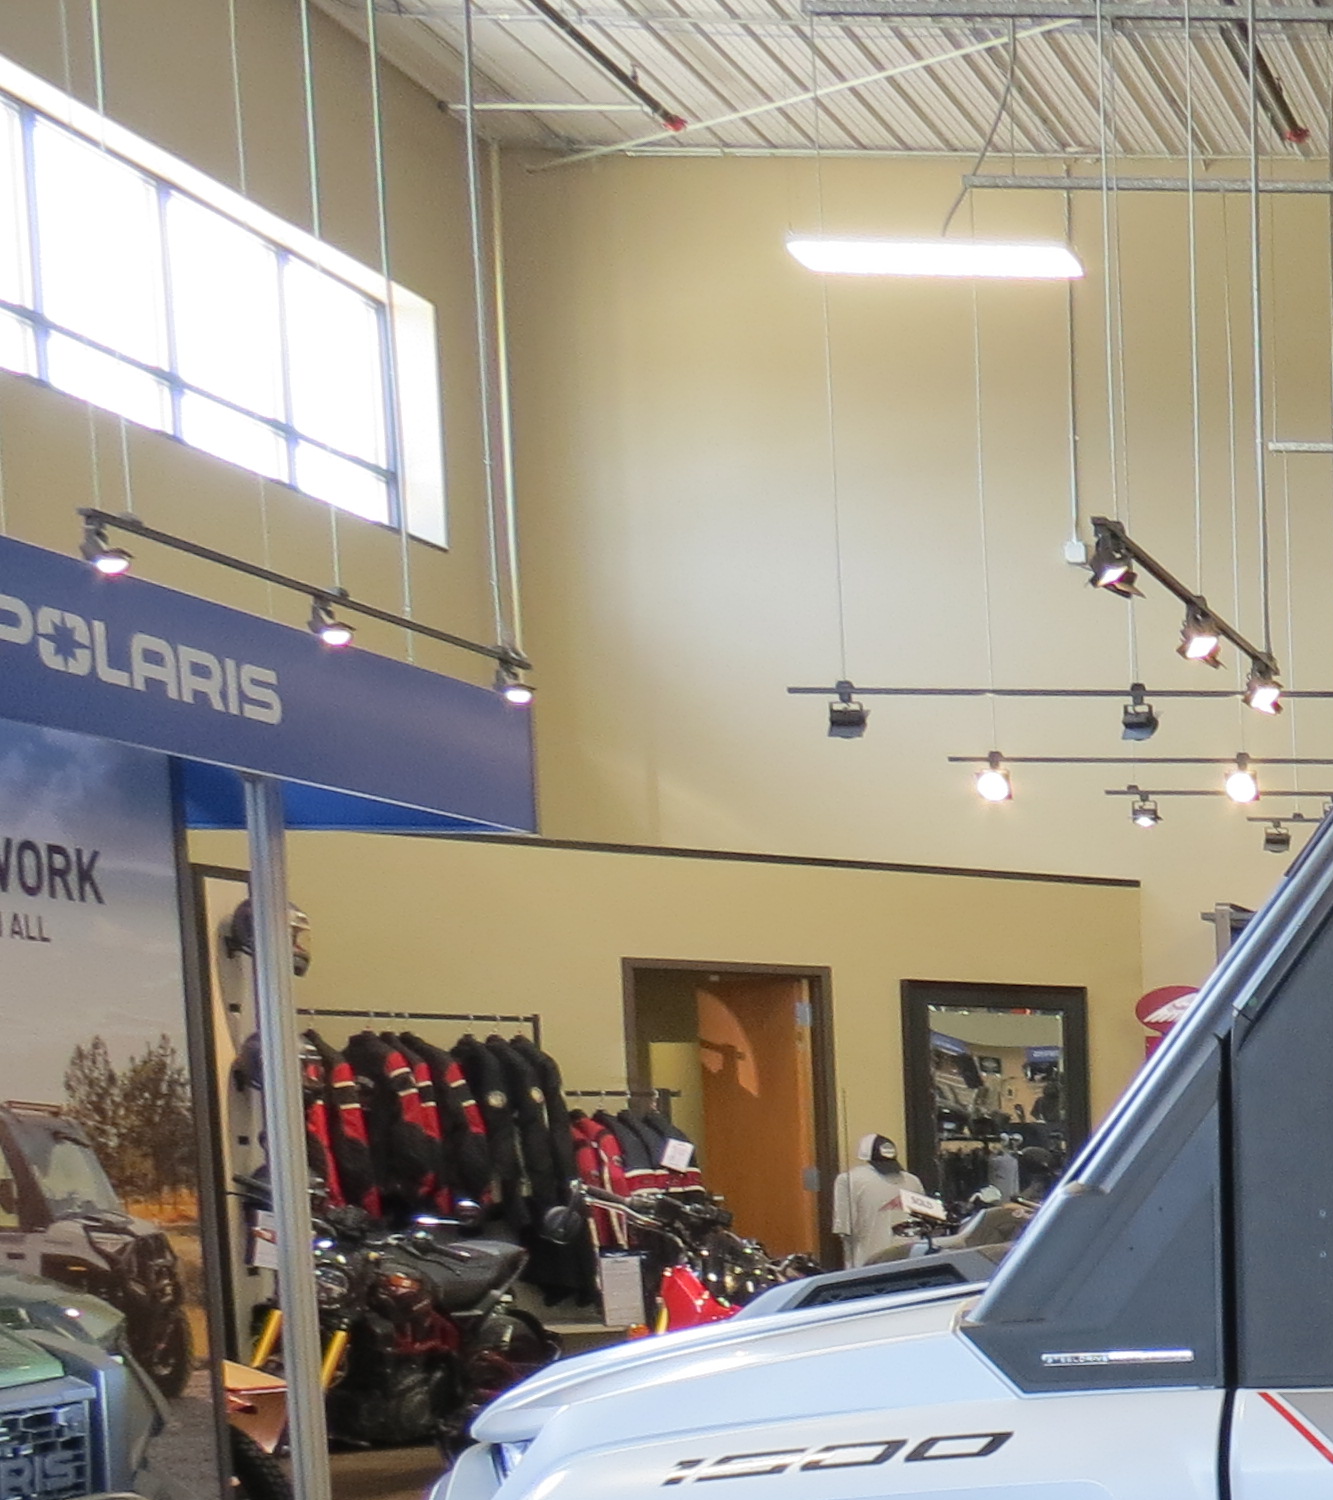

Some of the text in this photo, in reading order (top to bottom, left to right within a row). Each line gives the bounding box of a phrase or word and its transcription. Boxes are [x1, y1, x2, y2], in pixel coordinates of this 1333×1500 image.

[0, 595, 282, 725] POLARIS
[11, 912, 52, 942] ALL
[661, 1430, 1014, 1487] 1500
